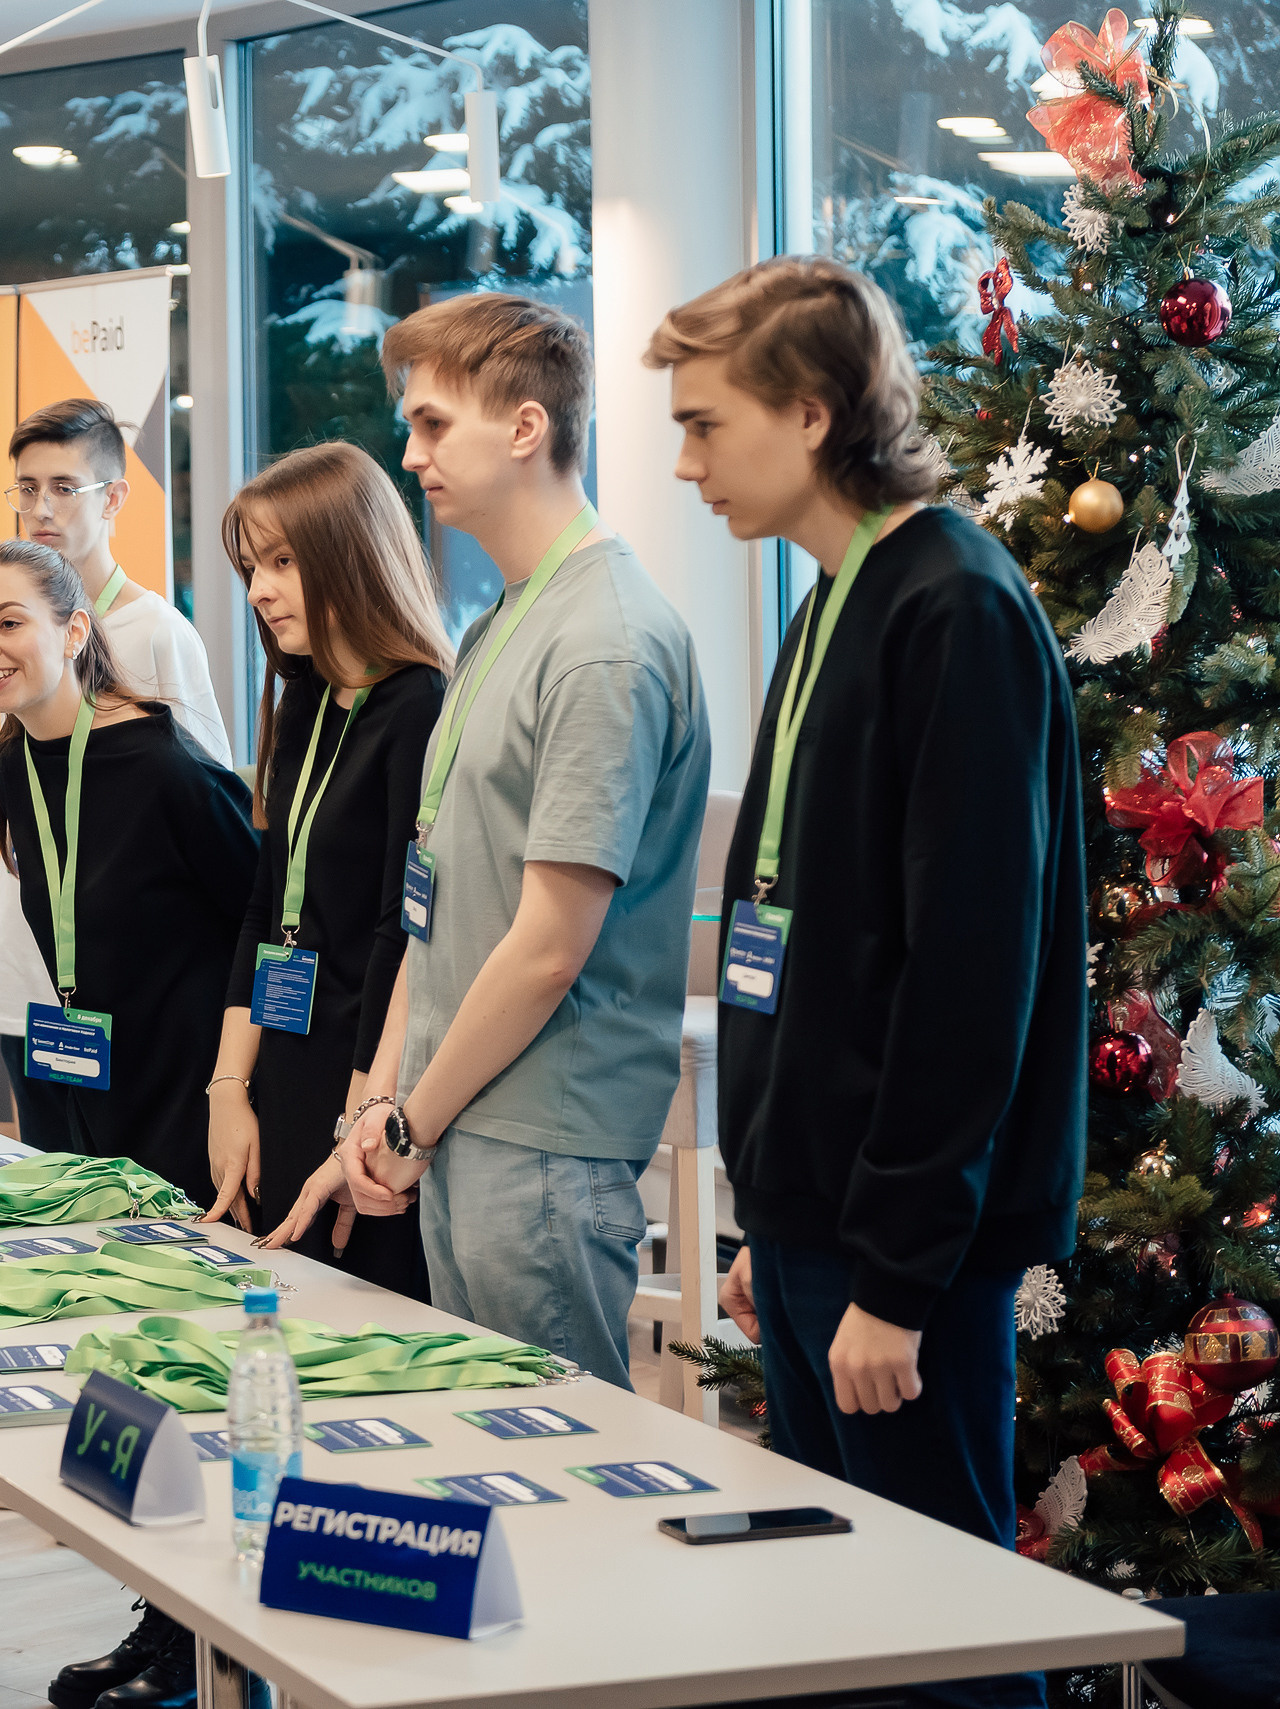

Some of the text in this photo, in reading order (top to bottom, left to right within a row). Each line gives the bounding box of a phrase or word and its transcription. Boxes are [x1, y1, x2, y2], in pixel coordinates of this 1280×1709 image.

[71, 316, 125, 353] bePaid
[49, 1073, 82, 1083] HELP-TEAM
[274, 1501, 482, 1559] РЕГИСТРАЦИЯ
[298, 1560, 438, 1601] УЧАСТНИКОВ
